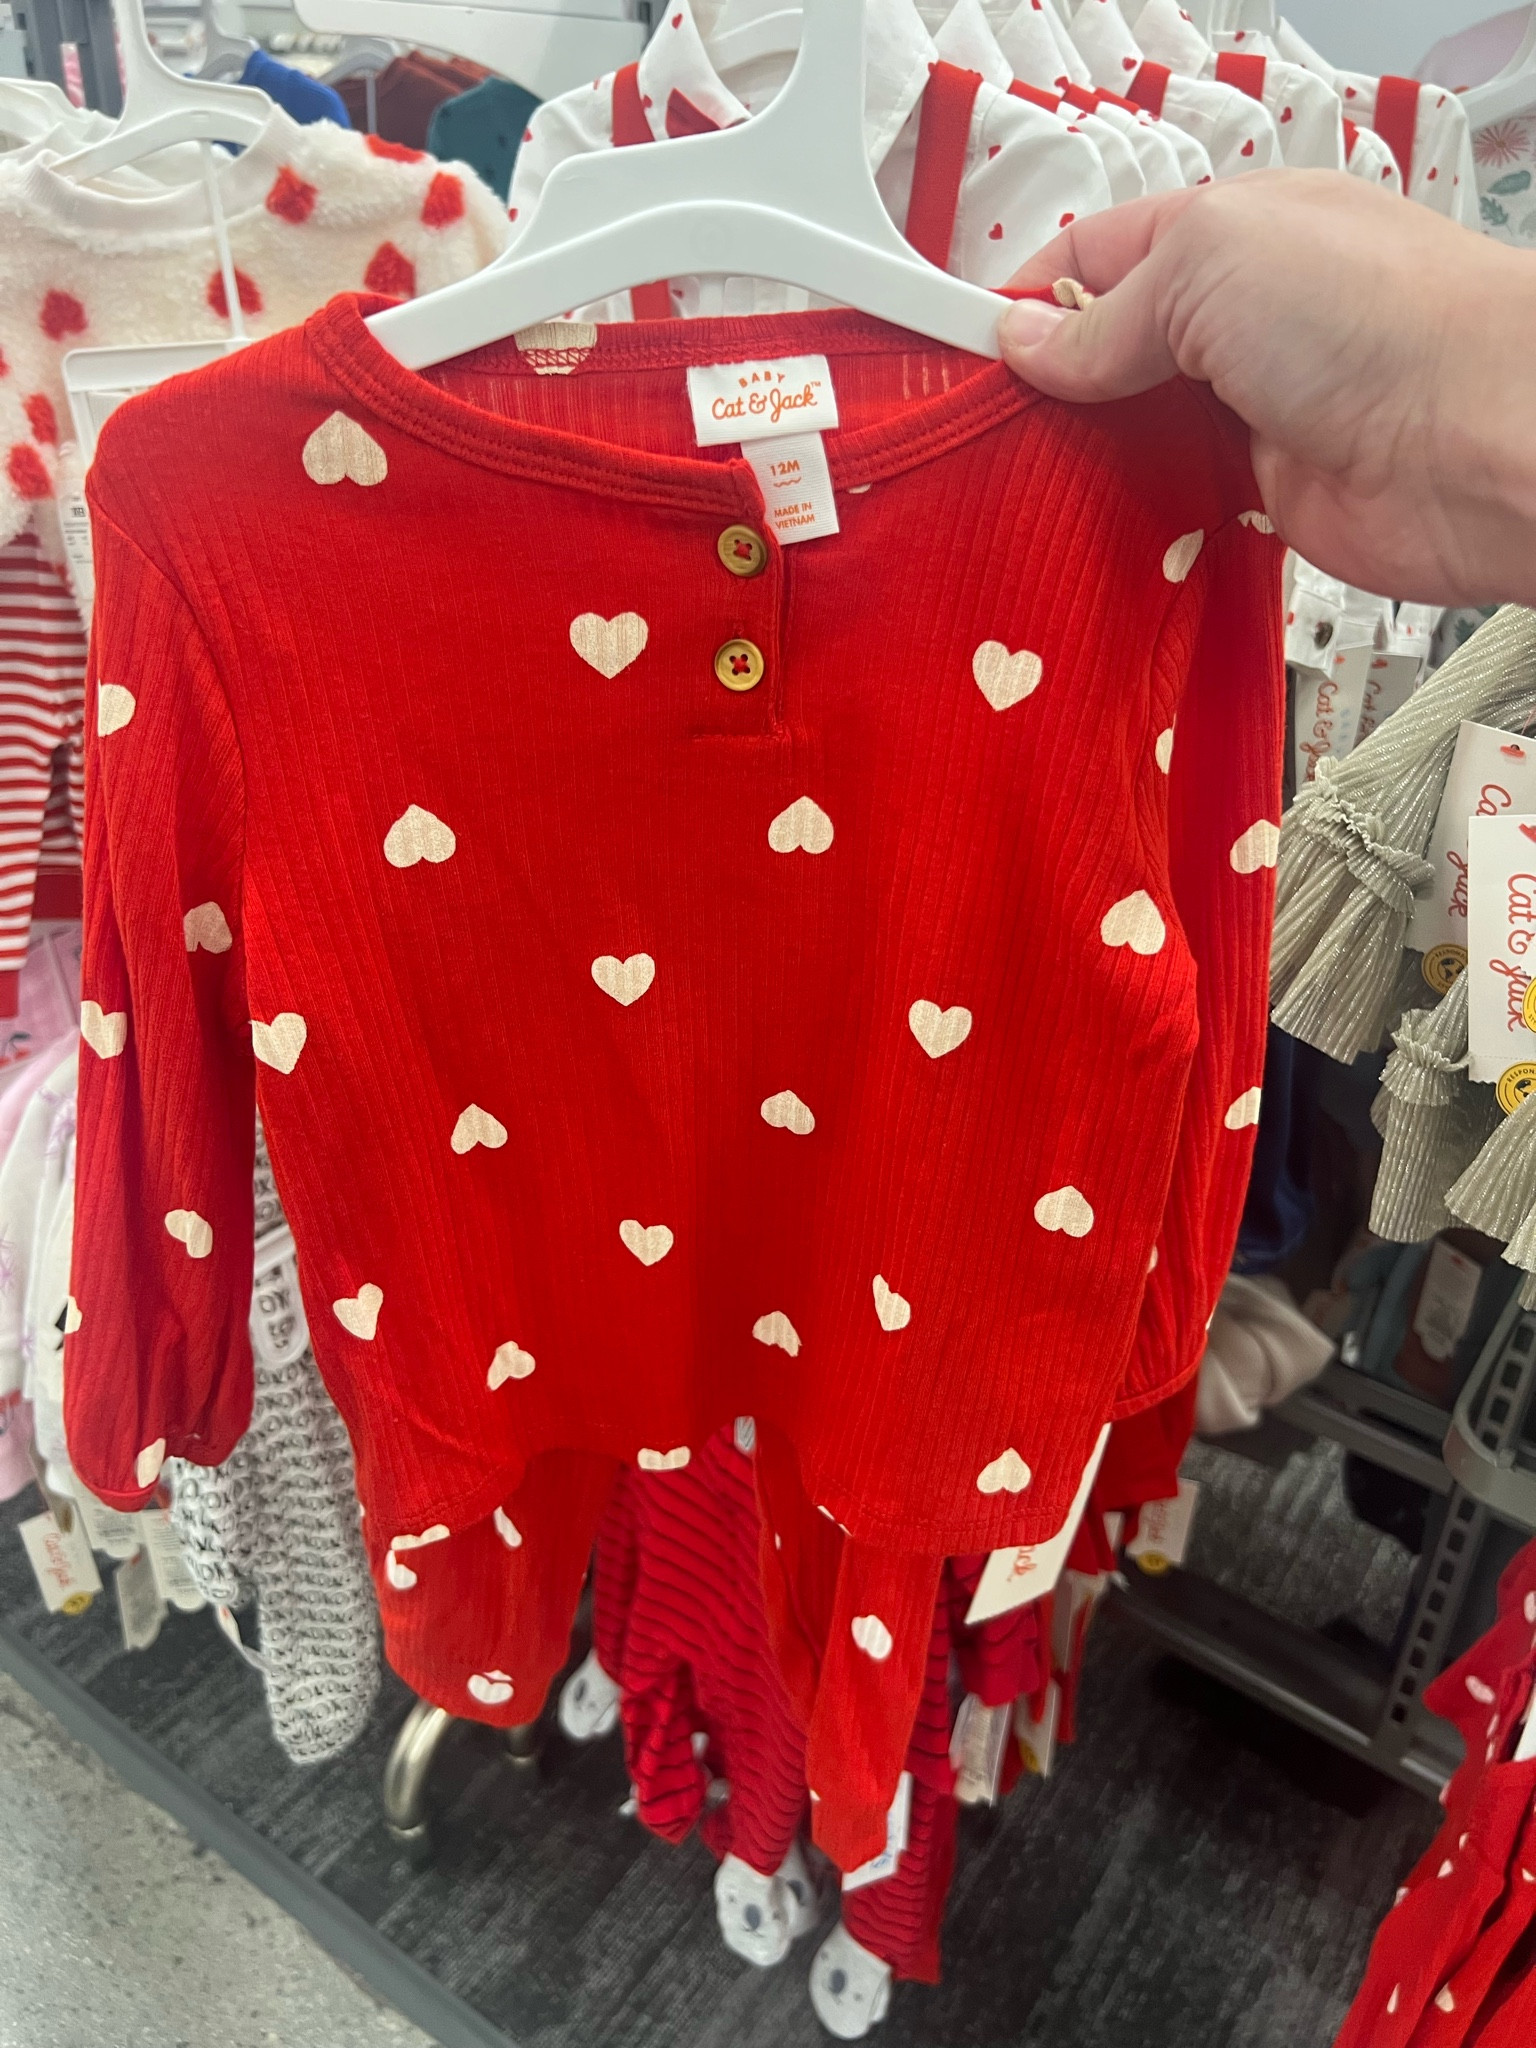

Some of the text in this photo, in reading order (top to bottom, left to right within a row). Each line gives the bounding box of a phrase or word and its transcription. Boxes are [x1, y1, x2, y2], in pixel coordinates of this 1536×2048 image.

[738, 370, 786, 388] BABY
[711, 397, 746, 420] Cat
[748, 392, 768, 414] &
[770, 459, 800, 477] 12M
[774, 501, 812, 518] MADE IN
[775, 513, 816, 530] VIETNAM
[1316, 681, 1339, 717] Cat
[1475, 783, 1512, 817] Ca
[1507, 873, 1536, 925] Cat
